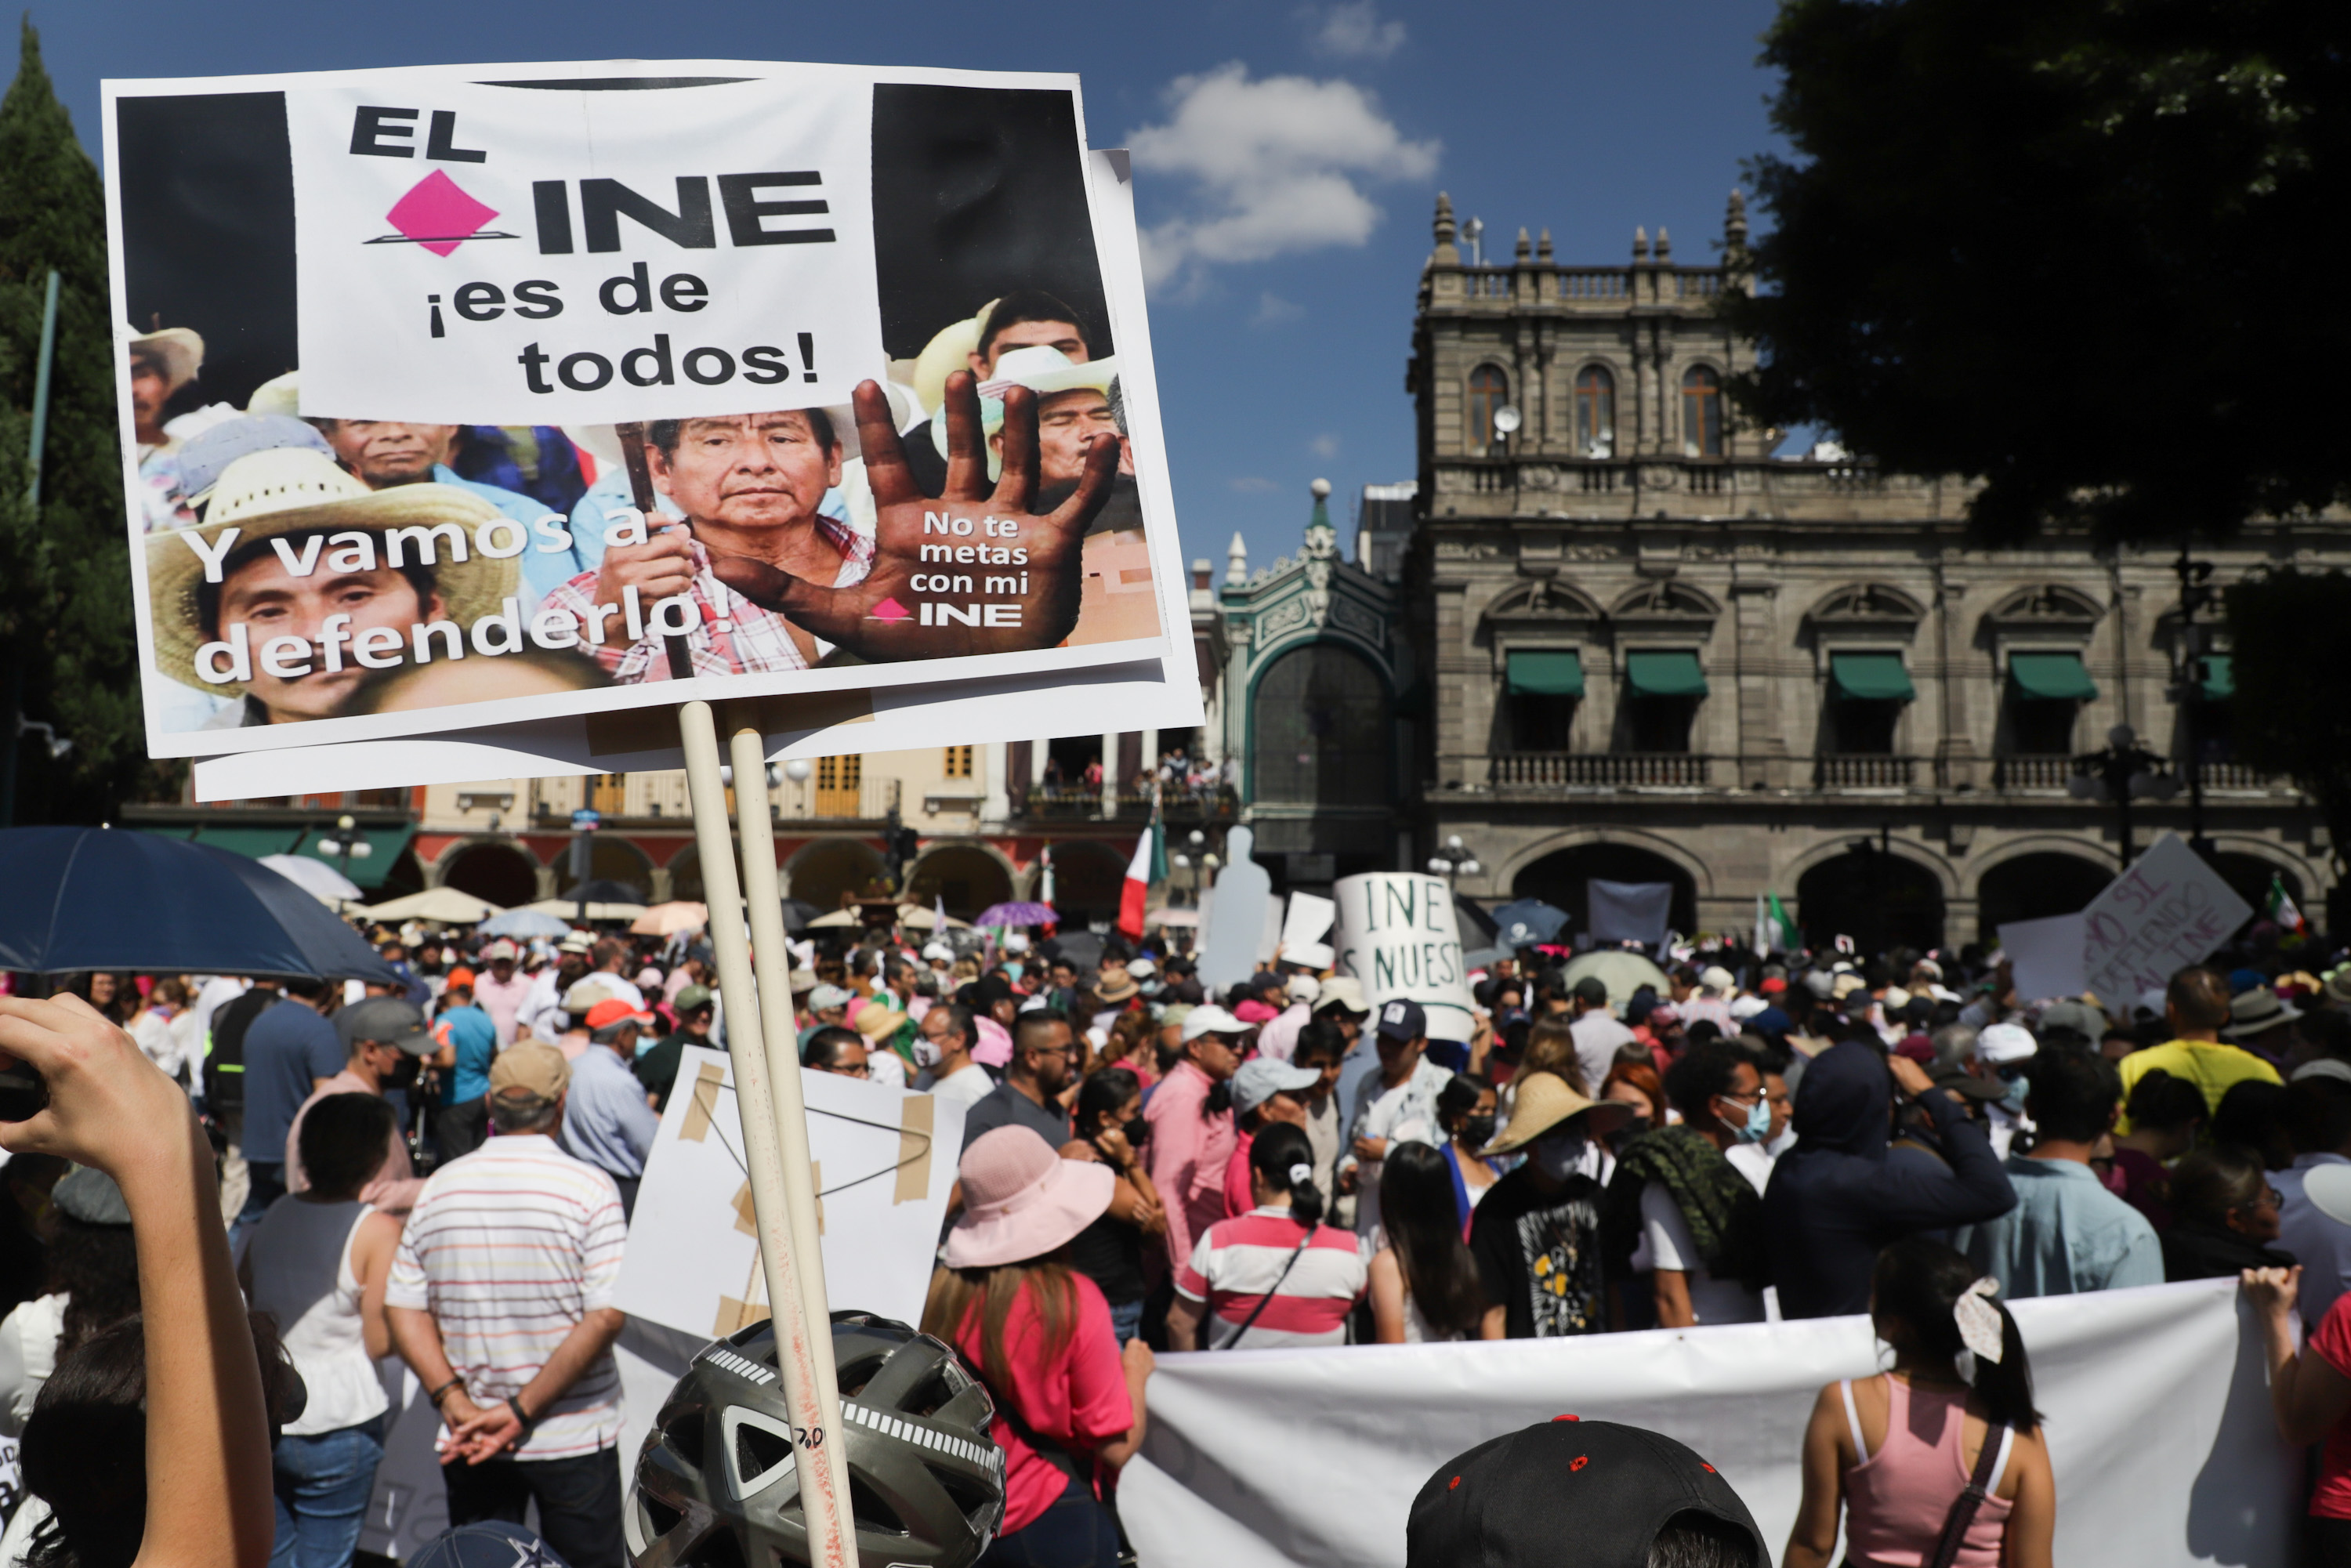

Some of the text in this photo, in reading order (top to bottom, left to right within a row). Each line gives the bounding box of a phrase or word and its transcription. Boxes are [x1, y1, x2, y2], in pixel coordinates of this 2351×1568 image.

[349, 105, 487, 164] EL
[532, 170, 837, 255] INE
[427, 261, 710, 339] ¡es de
[517, 330, 819, 395] todos!
[180, 506, 649, 583] Y vamos a
[919, 541, 1029, 566] metas
[923, 510, 1019, 538] No te
[910, 570, 1029, 595] con mi
[194, 581, 734, 684] defenderlo!
[919, 603, 1023, 628] INE
[1364, 878, 1444, 933] INE
